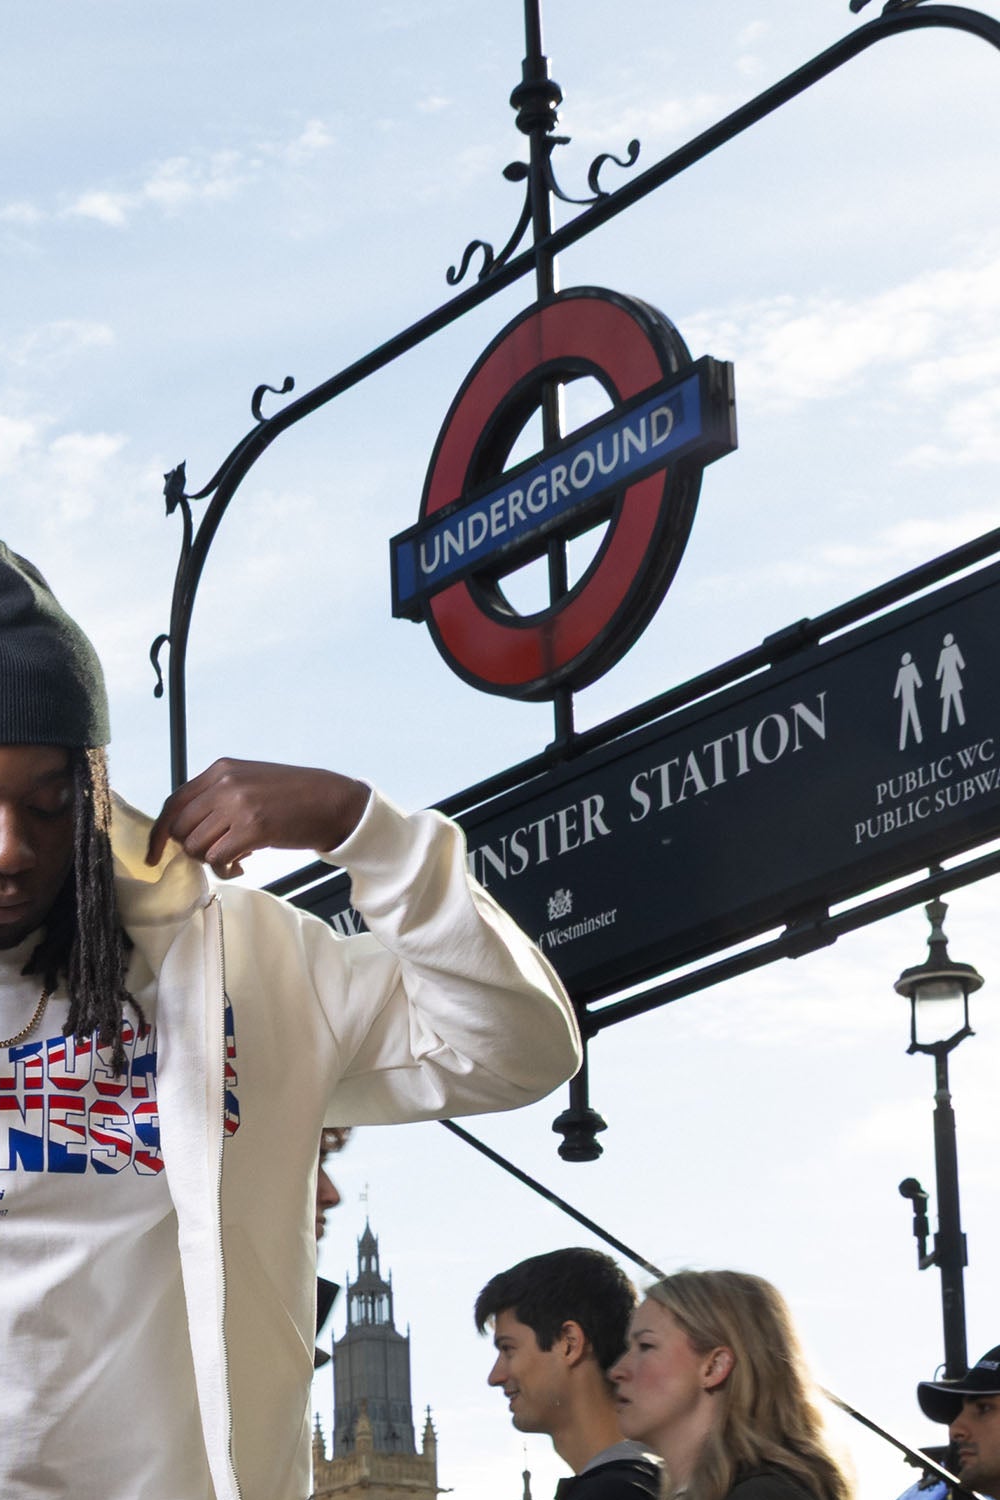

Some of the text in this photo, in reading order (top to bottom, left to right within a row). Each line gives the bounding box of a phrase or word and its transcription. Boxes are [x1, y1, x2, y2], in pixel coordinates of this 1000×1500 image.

[419, 405, 675, 575] UNDERGROUND
[628, 690, 828, 823] STATION
[875, 738, 995, 806] PUBLIC WC
[854, 795, 932, 845] PUBLIC
[545, 907, 618, 949] Westminster
